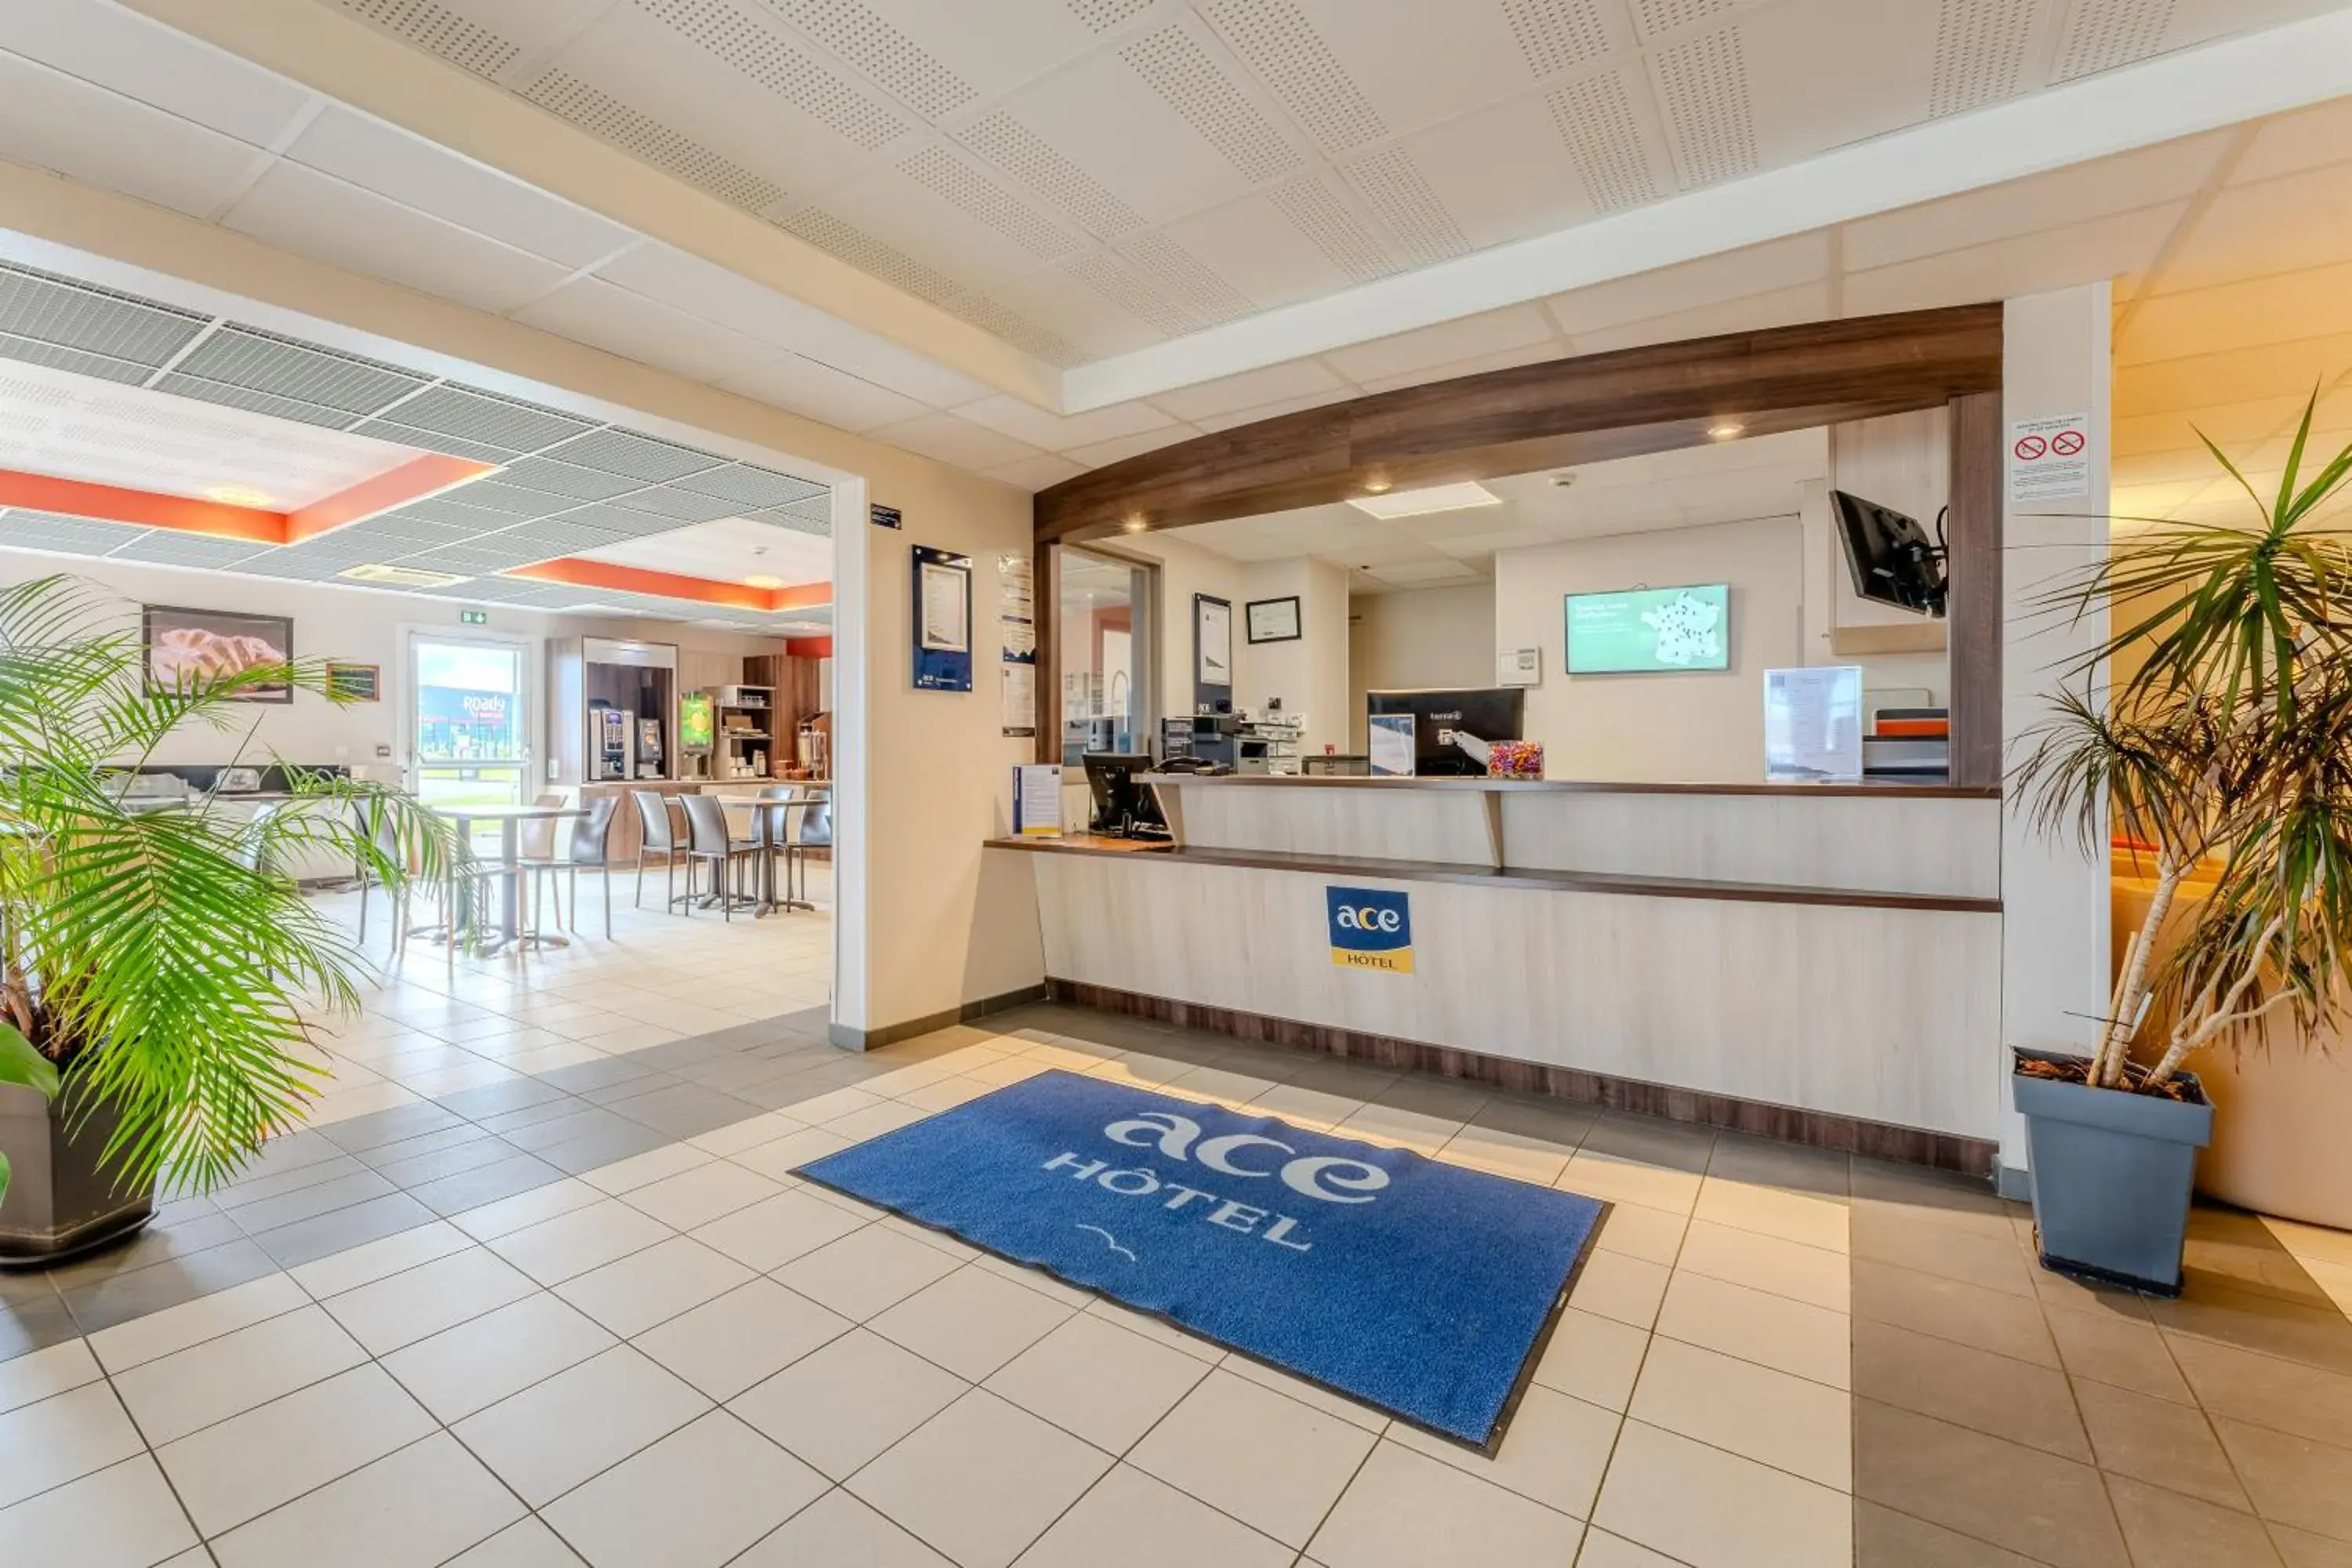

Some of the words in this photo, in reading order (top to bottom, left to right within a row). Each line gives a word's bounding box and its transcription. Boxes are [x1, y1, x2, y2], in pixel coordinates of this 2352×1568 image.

[1337, 905, 1400, 932] ace
[1347, 953, 1398, 970] HÔTEL
[1104, 1112, 1390, 1203] ace
[1042, 1152, 1313, 1251] HÔTEL
